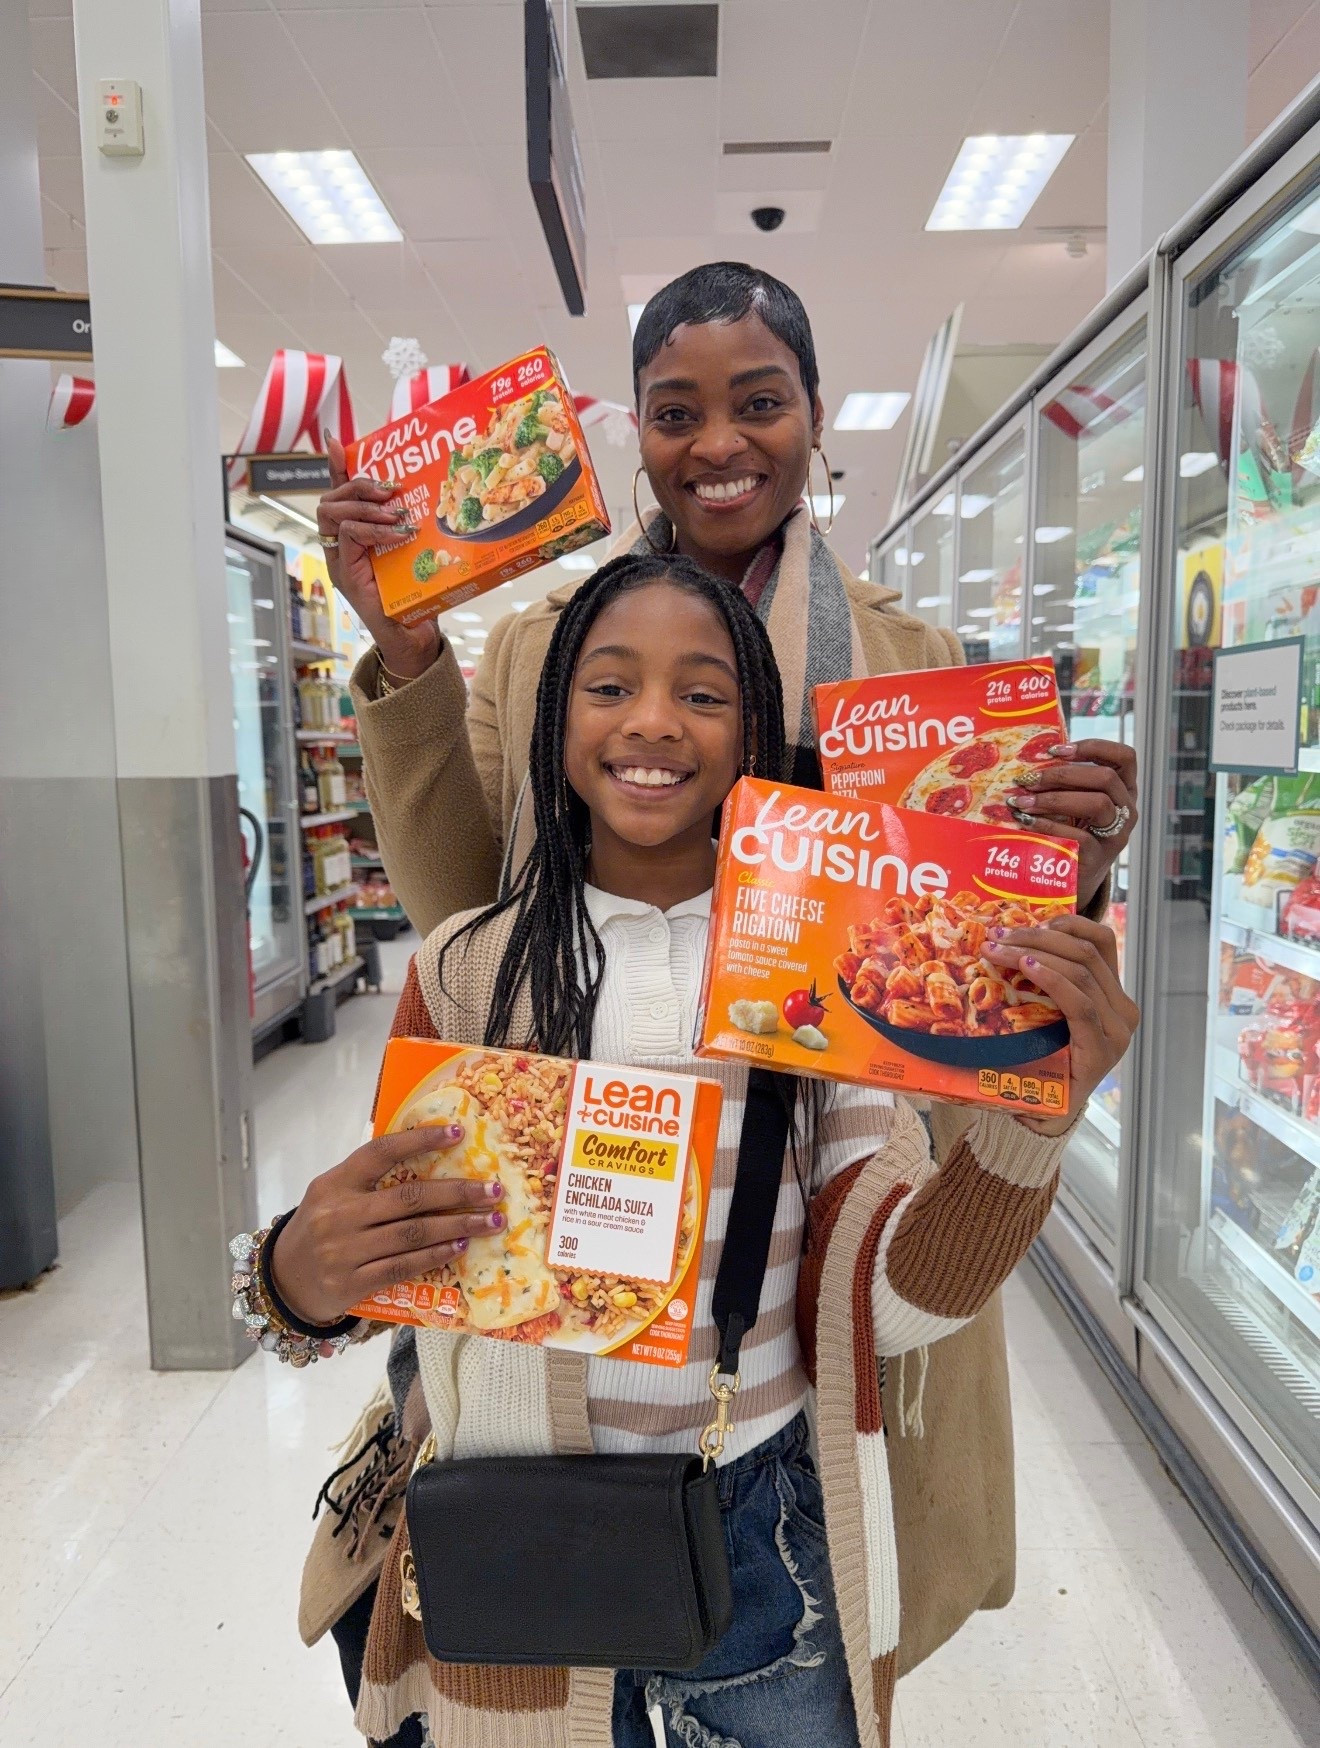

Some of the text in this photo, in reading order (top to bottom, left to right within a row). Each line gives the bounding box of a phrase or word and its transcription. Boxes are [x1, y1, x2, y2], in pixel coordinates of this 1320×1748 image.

[517, 357, 543, 382] 260
[520, 372, 545, 388] calories
[492, 387, 514, 404] protein
[357, 417, 428, 472] Lean
[403, 483, 431, 509] PASTA
[421, 501, 430, 517] &
[1018, 674, 1051, 693] 400
[987, 694, 1013, 706] protein
[1020, 690, 1050, 700] calories
[831, 693, 919, 734] Lean
[830, 761, 866, 773] Signature
[830, 768, 886, 790] PEPPERONI
[754, 790, 880, 842] Lean
[984, 866, 1019, 880] protein
[1029, 854, 1071, 878] 360
[737, 870, 776, 888] Classic
[1030, 874, 1068, 889] calories
[735, 886, 826, 924] FIVE CHEESE
[732, 910, 801, 944] RIGATONI
[729, 937, 789, 957] pasta in a sweet
[726, 962, 770, 979] with cheese
[727, 949, 808, 973] tomato sauce covered
[746, 1040, 755, 1053] OZ
[755, 1041, 775, 1059] (283g)
[981, 1071, 997, 1084] 360
[583, 1077, 681, 1118] Lean
[582, 1133, 669, 1167] Comfort
[588, 1158, 655, 1175] CRAVINGS
[567, 1173, 613, 1193] CHICKEN
[565, 1190, 654, 1217] ENCHILADA SUIZA
[562, 1215, 575, 1224] rice
[575, 1217, 581, 1225] in
[587, 1220, 602, 1228] sour
[602, 1222, 624, 1231] cream
[624, 1225, 645, 1234] sauce
[563, 1208, 578, 1216] with
[579, 1210, 597, 1218] white
[597, 1213, 614, 1221] meat
[614, 1214, 640, 1225] chicken
[558, 1235, 579, 1251] 300
[557, 1250, 577, 1259] calories
[632, 1342, 683, 1364] NET WT 9 OZ (255g)
